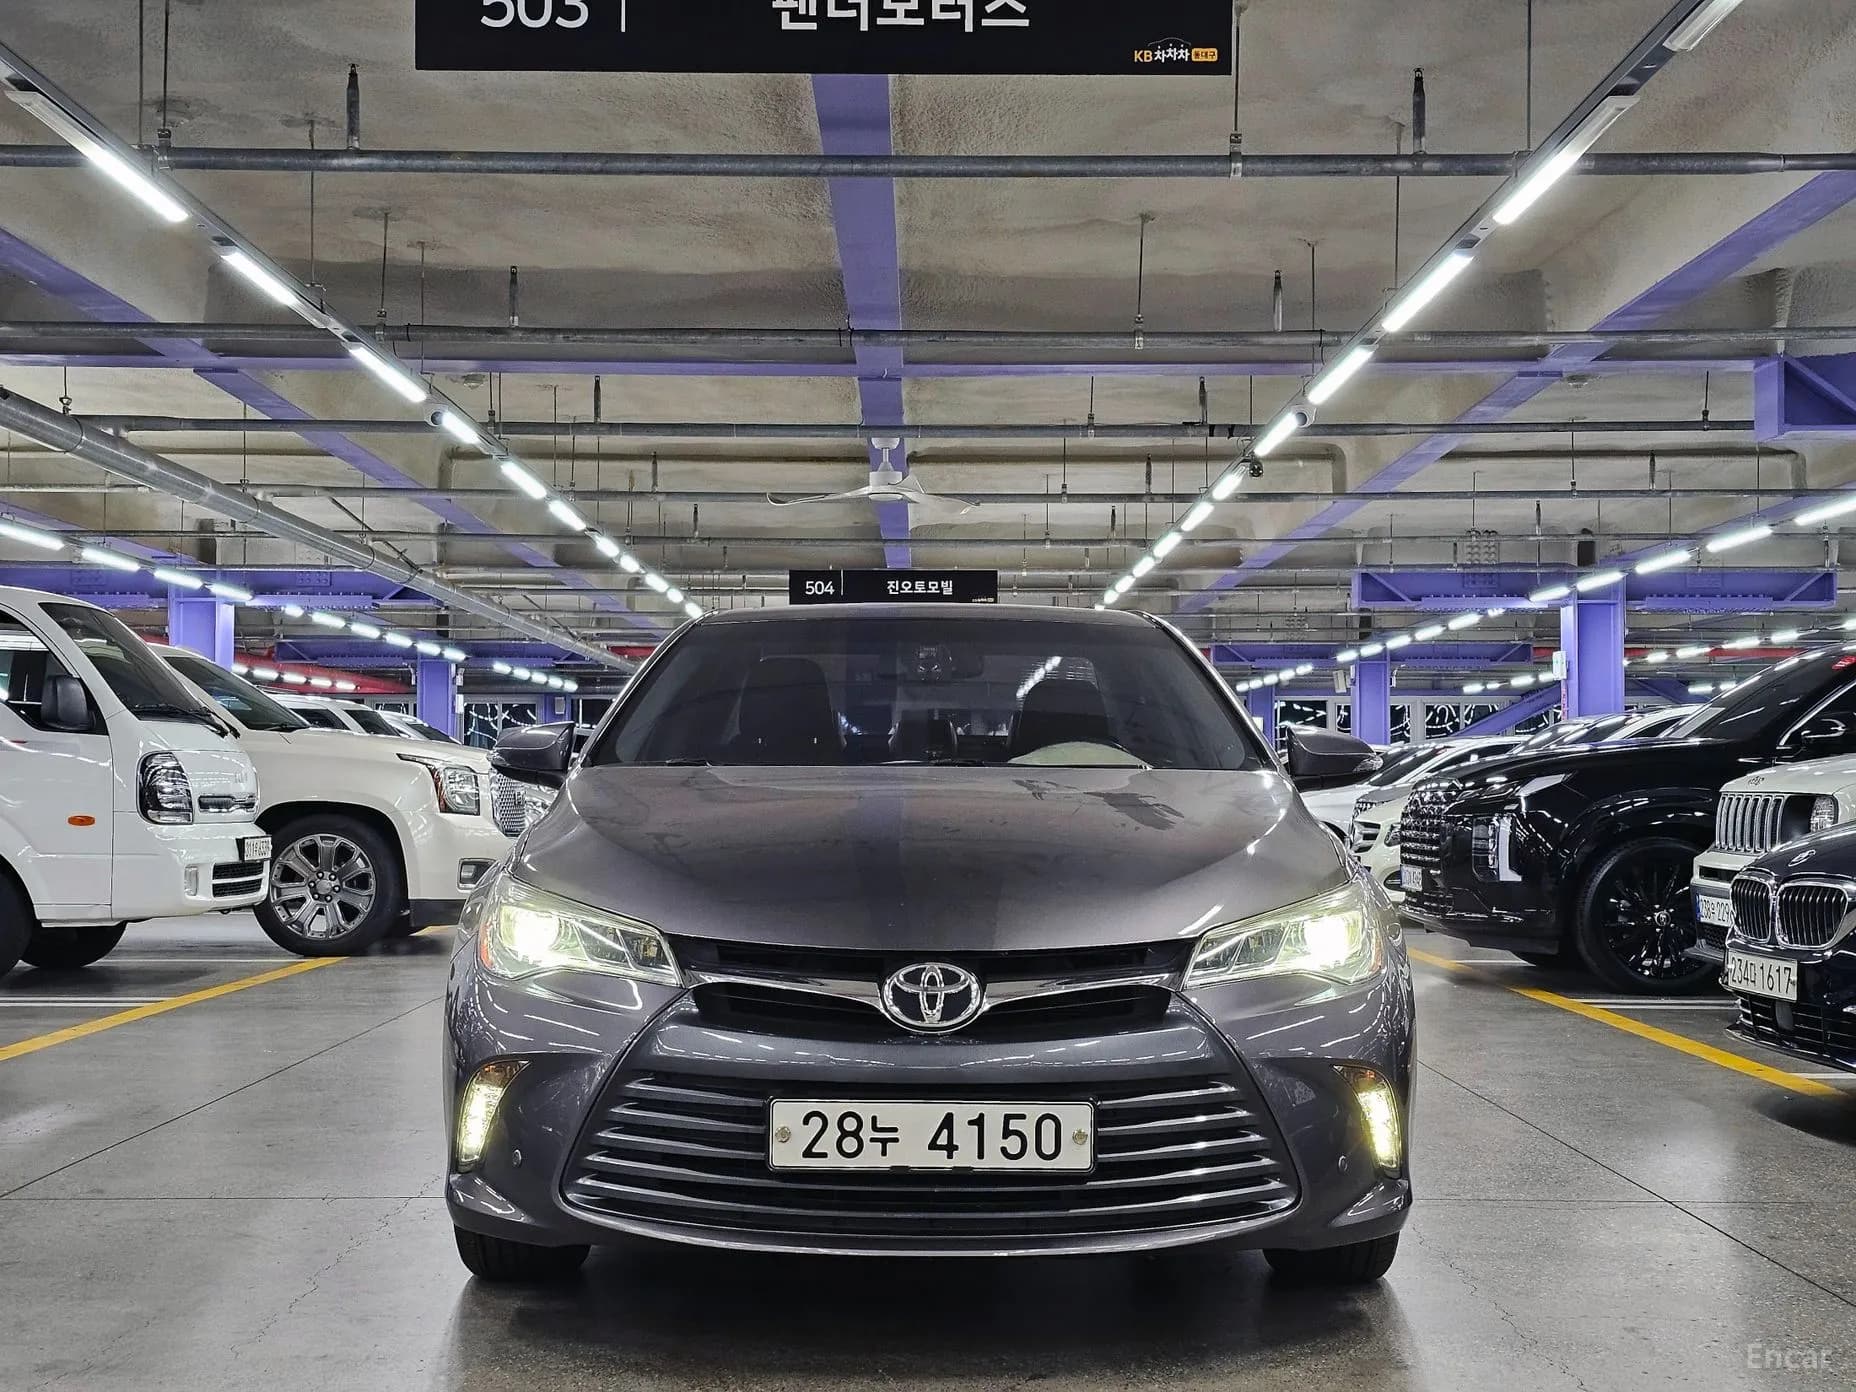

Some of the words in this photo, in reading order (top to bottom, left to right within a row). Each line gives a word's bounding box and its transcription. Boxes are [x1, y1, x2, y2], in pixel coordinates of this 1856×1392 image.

[480, 0, 589, 29] 503
[805, 580, 835, 595] 504
[887, 580, 953, 596] 진오토모빌
[1716, 901, 1730, 923] 229
[1760, 962, 1792, 994] 1617
[802, 1111, 900, 1159] 28누
[927, 1112, 1062, 1161] 4150
